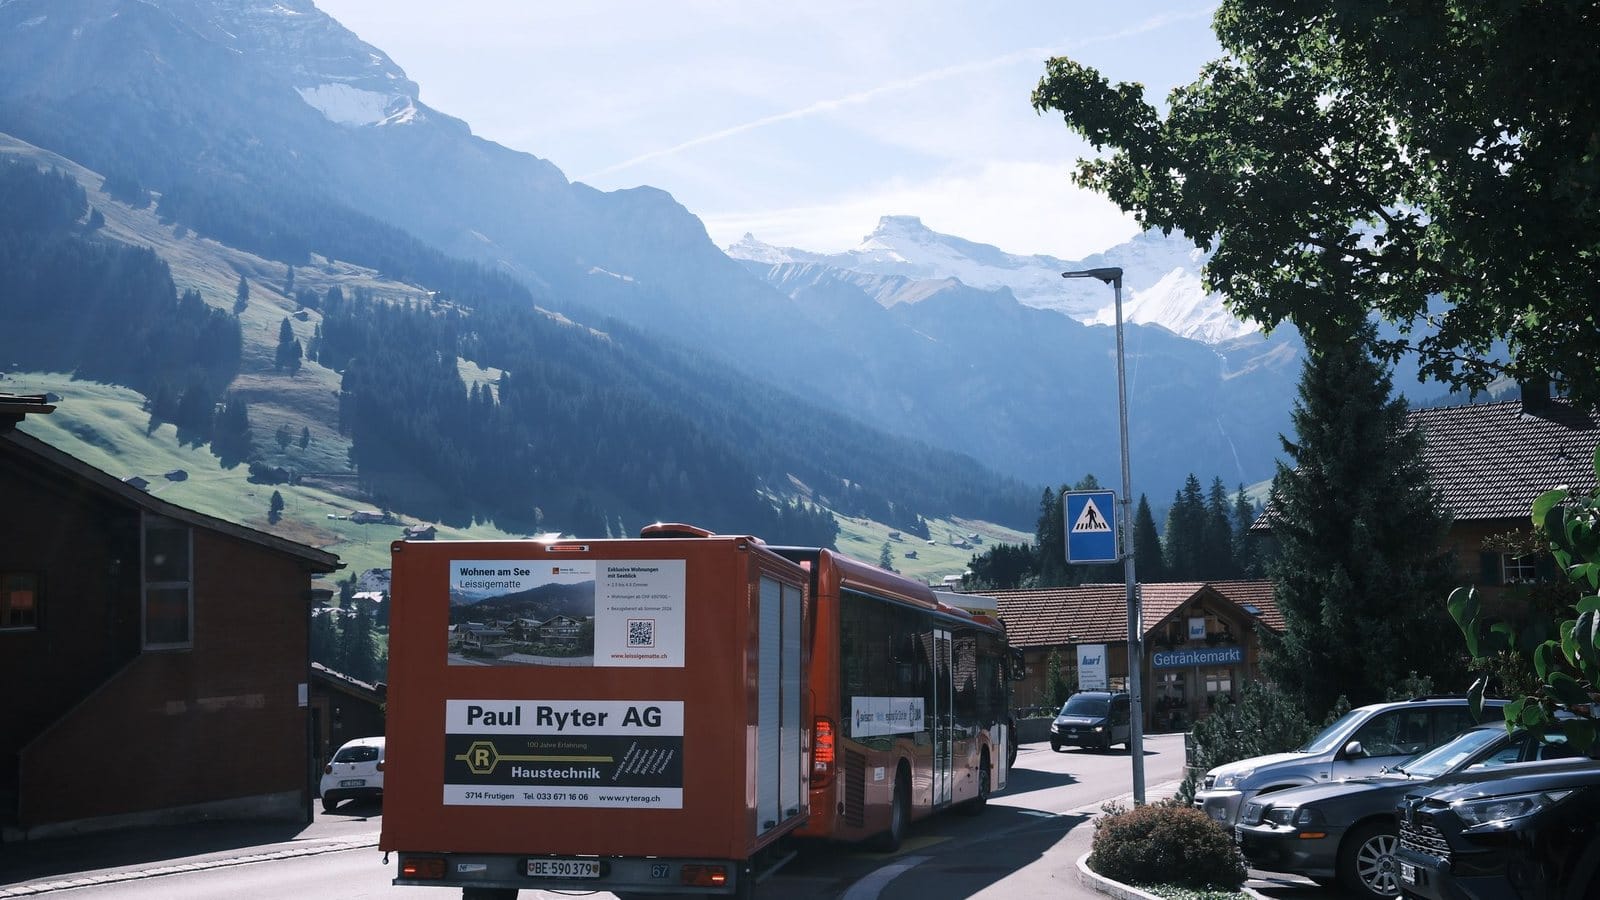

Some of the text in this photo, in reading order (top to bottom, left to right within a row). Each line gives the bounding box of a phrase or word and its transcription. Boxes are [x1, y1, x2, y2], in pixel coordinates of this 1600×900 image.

[460, 567, 495, 576] Wohnen
[513, 567, 531, 576] See
[460, 580, 521, 590] Leissigematte
[610, 652, 668, 660] www.leissigematte.ch
[1153, 648, 1241, 666] Getränkemarkt
[467, 705, 662, 731] Paul Ryter AG
[557, 742, 588, 750] Erfahrung
[474, 750, 490, 767] R
[511, 766, 601, 779] Haustechnik
[464, 791, 483, 799] 3714
[484, 792, 515, 801] Frutigen
[578, 793, 589, 801] 06
[598, 794, 661, 803] www.ryterag.ch
[652, 865, 668, 878] 67
